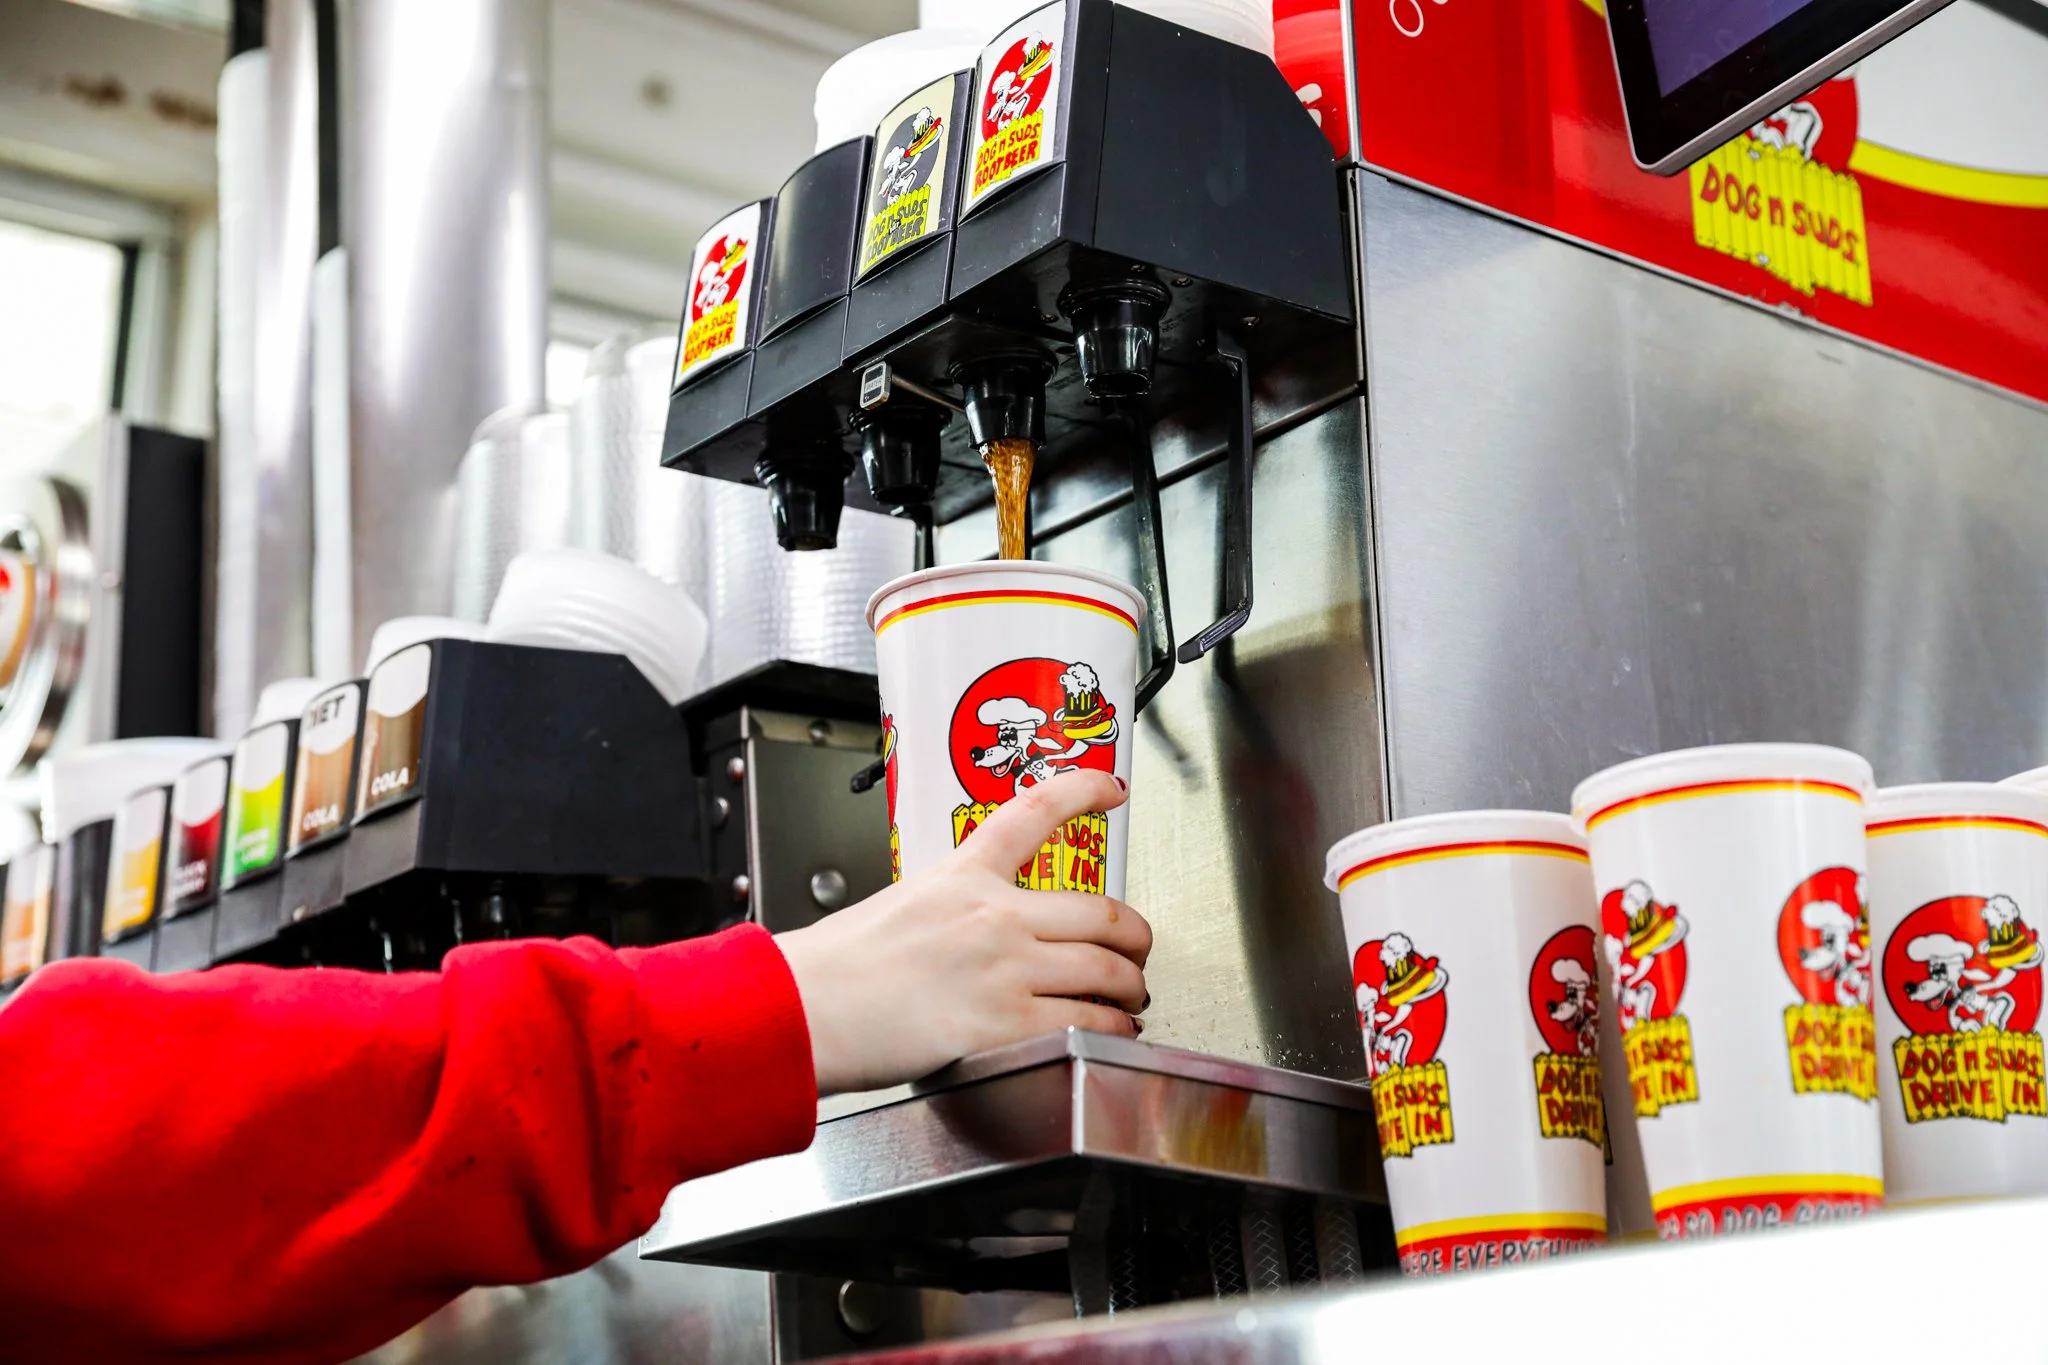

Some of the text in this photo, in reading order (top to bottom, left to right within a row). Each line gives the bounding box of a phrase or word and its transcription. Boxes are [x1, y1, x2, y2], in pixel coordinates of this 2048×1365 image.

[1008, 123, 1041, 147] SUDS
[897, 199, 927, 220] SUDS
[1700, 162, 1859, 263] DOG n SUDS
[371, 767, 409, 796] COLA
[303, 804, 339, 831] COLA
[1070, 856, 1099, 887] IN
[1792, 1018, 1840, 1048] DOG
[1902, 1048, 1957, 1079] DOG
[1985, 1046, 2041, 1078] SUDS
[1394, 1081, 1443, 1108] SUDS
[1909, 1079, 2041, 1111] DRIVE IN
[1415, 1111, 1443, 1136] IN
